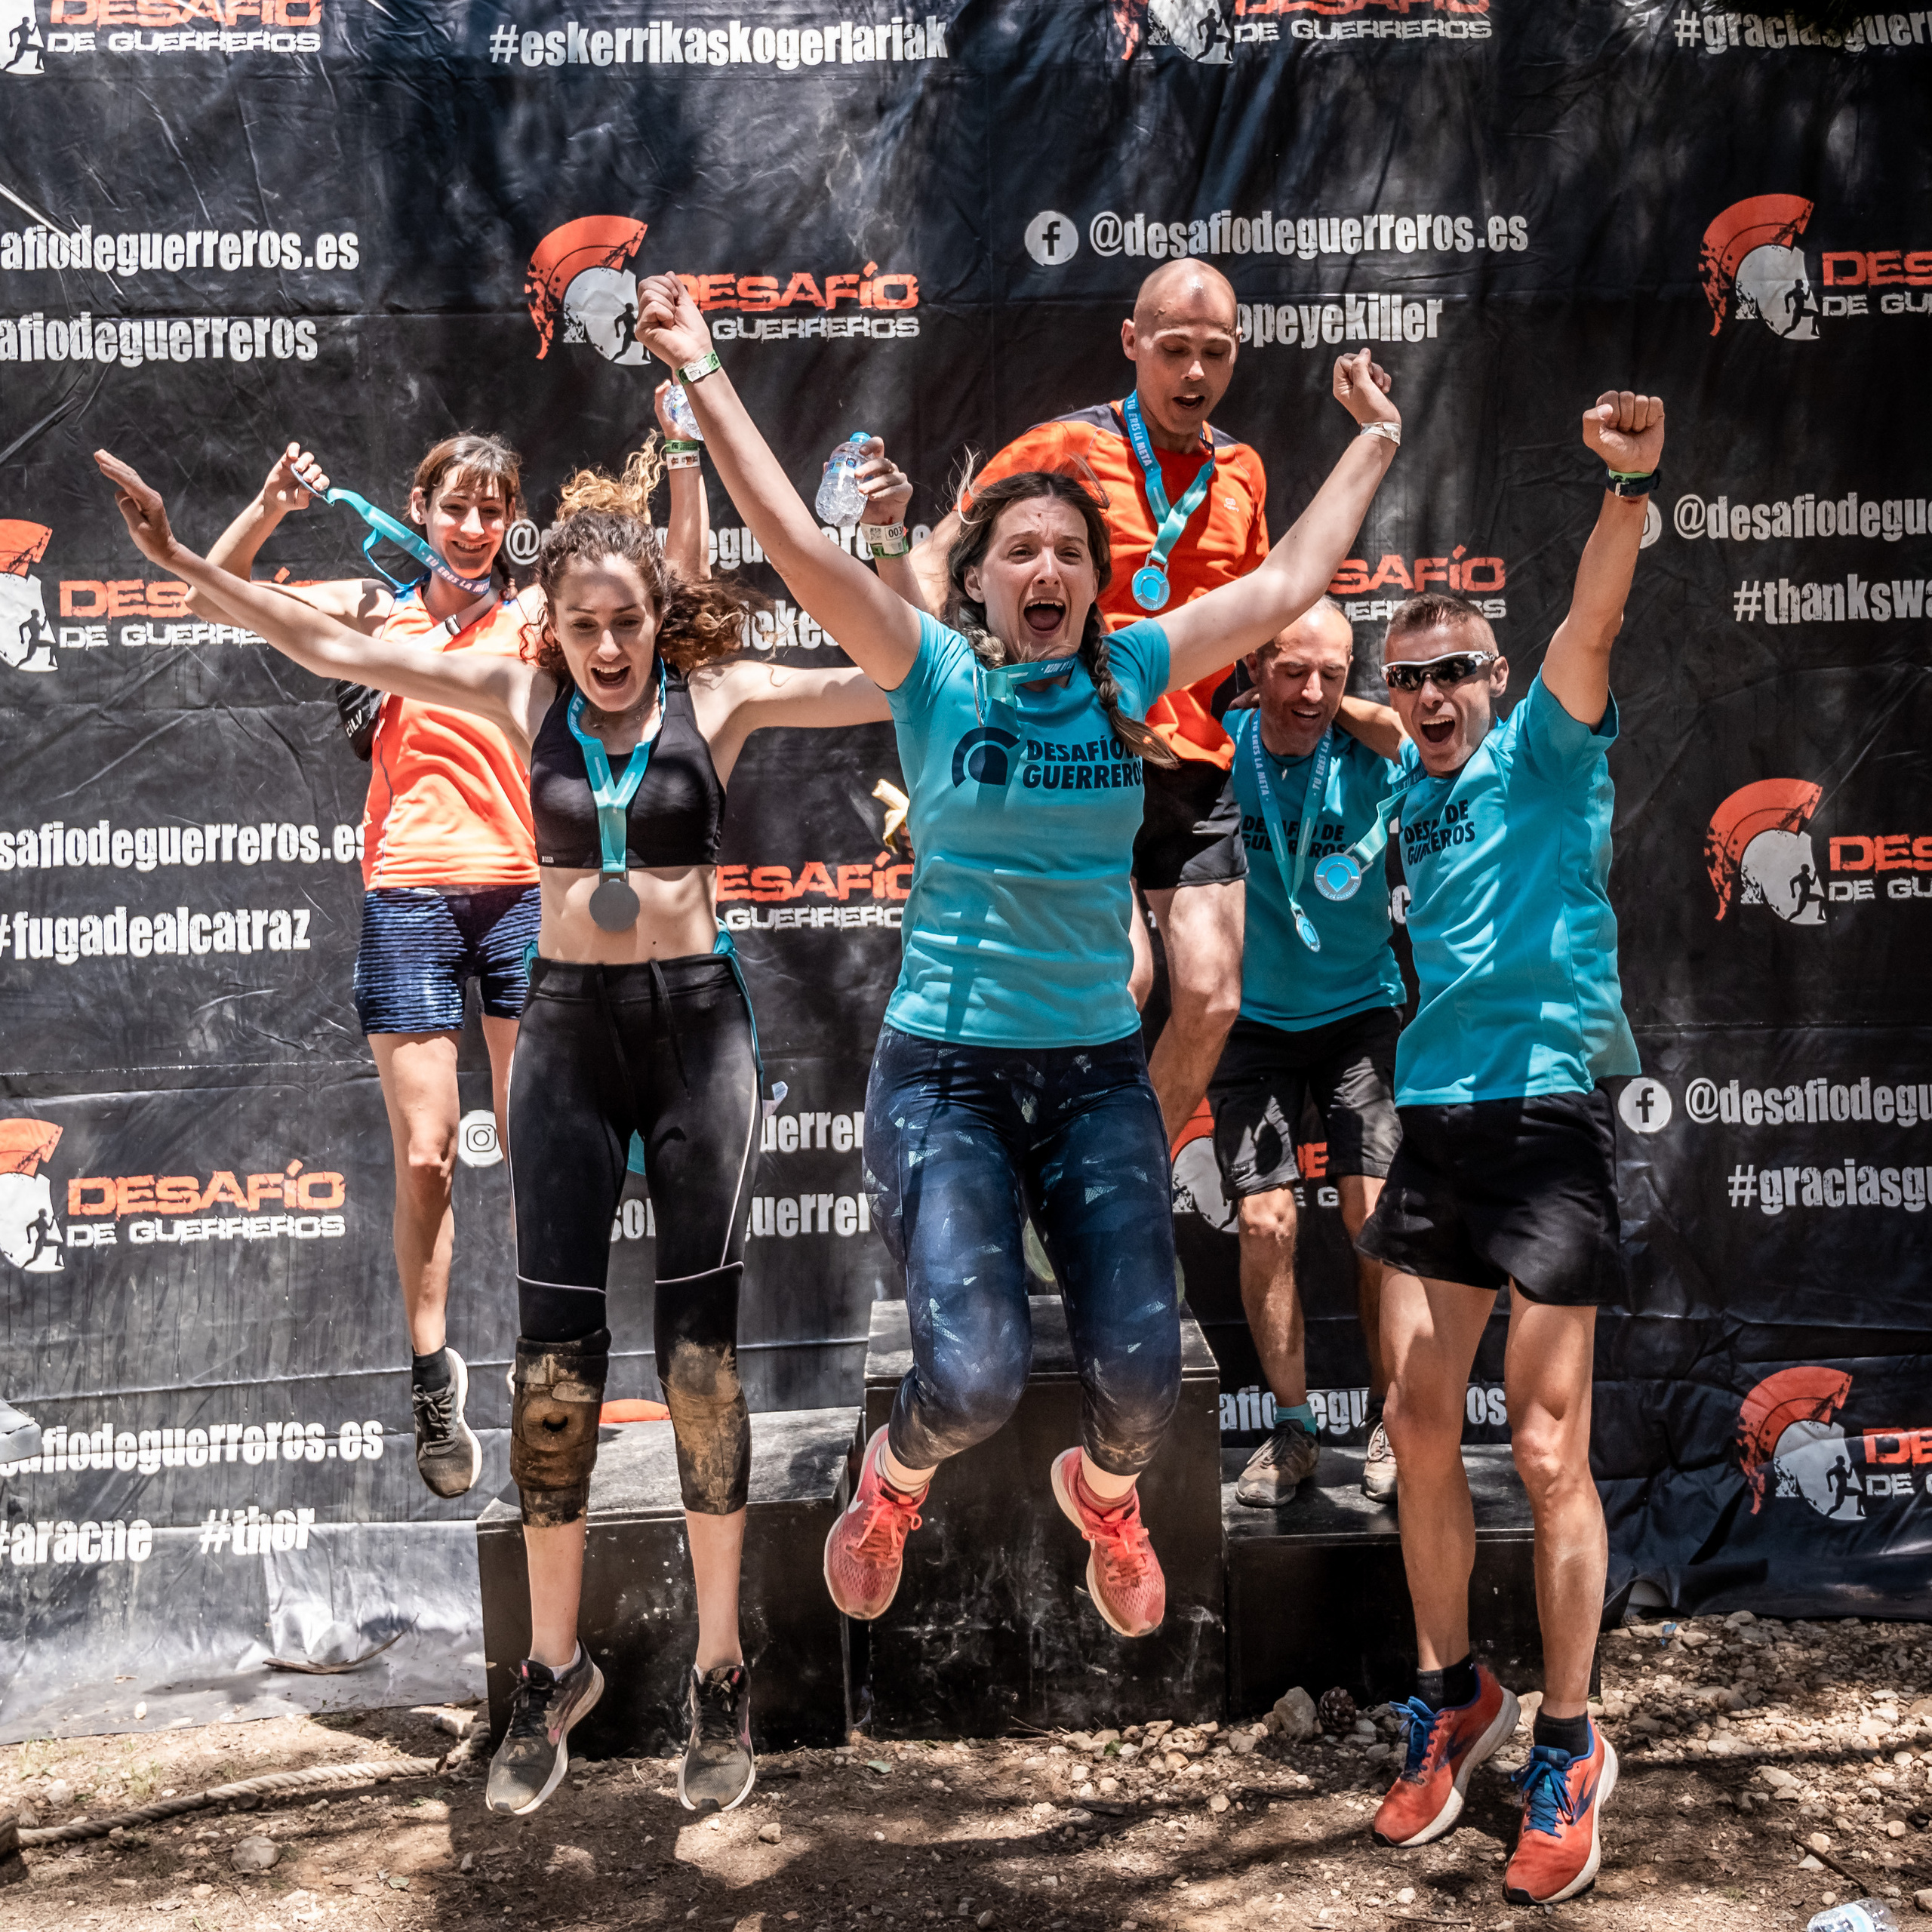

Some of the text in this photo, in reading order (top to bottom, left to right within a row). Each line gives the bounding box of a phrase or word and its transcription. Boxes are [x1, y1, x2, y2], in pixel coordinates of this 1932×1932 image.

[48, 29, 321, 54] DE GUERREROS
[491, 16, 949, 69] #eskerrikaskogerlariak
[1234, 19, 1492, 44] DE GUERREROS
[1090, 210, 1528, 260] @desafiodeguerreros.es
[1823, 291, 1932, 318] DE GU
[712, 315, 920, 343] GUERREROS
[1128, 413, 1141, 432] ERES
[1134, 430, 1143, 441] LA
[1137, 441, 1152, 466] META
[1674, 491, 1932, 541] @desafiodegu
[438, 567, 460, 585] ERES
[460, 580, 472, 591] LA
[60, 626, 109, 650] DE
[1027, 735, 1124, 761] DESAFÍO
[1252, 734, 1261, 755] ERES
[1254, 758, 1263, 769] LA
[1315, 754, 1326, 777] ERES
[1321, 740, 1330, 753] LA
[1257, 771, 1269, 796] META
[1444, 799, 1469, 824] DE
[1321, 823, 1345, 841] DE
[1829, 878, 1875, 903] DE
[68, 1160, 346, 1220] DESAFÍO
[1727, 1158, 1932, 1214] #graciasg
[67, 1215, 346, 1247] DE GUERREROS
[1866, 1472, 1915, 1497] DE
